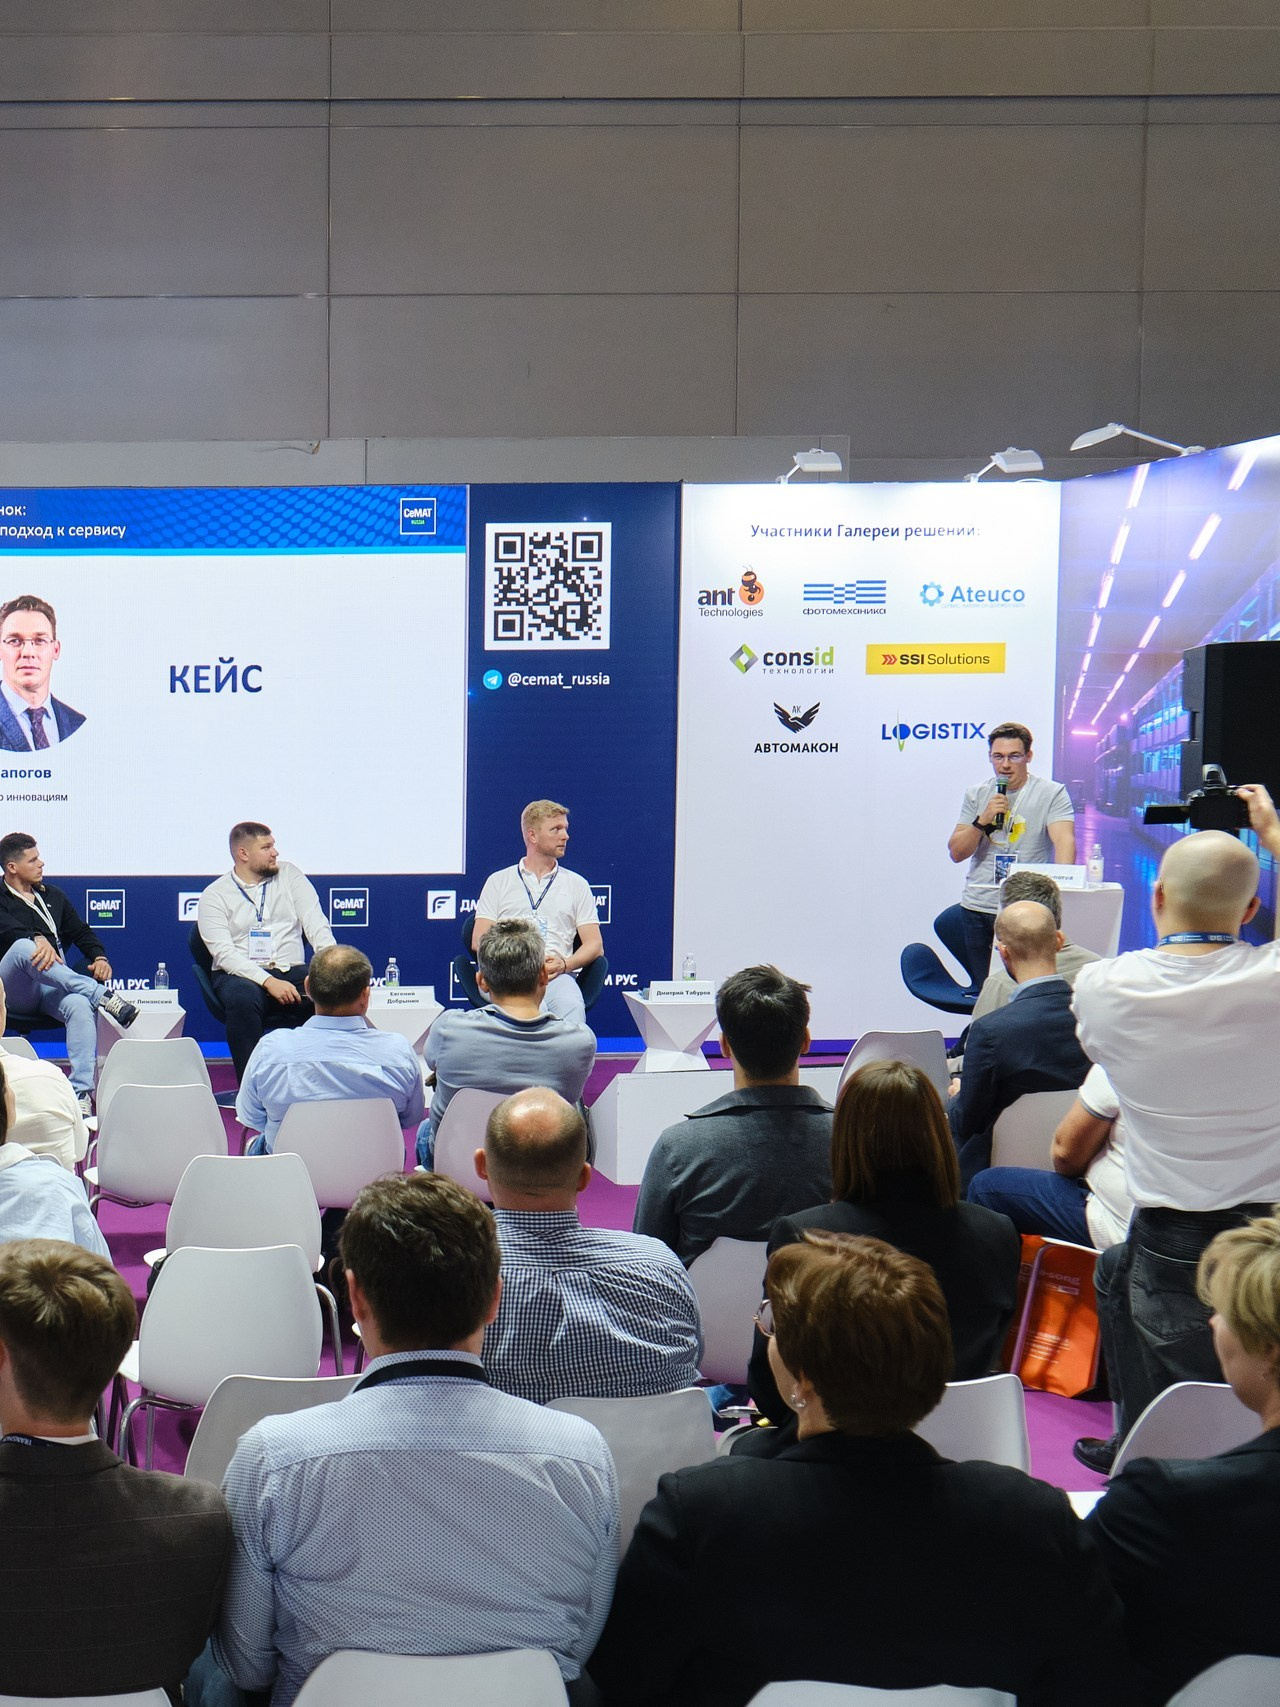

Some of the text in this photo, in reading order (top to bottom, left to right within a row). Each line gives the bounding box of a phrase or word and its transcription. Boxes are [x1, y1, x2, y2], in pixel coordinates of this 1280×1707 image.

[403, 508, 433, 518] CeMAT
[0, 525, 54, 539] подход
[57, 526, 65, 537] к
[69, 525, 127, 540] сервису
[751, 524, 981, 541] Участники Галереи решений:
[697, 586, 735, 607] ant
[950, 586, 1025, 602] Ateuco
[699, 607, 764, 619] Technologies
[802, 607, 887, 617] фотомеханика
[763, 646, 834, 666] consid
[899, 653, 990, 665] SSI Solutions
[170, 657, 262, 693] КЕЙС
[508, 672, 610, 689] @cemat_russia
[881, 722, 987, 740] LOGISTIX
[754, 742, 839, 753] АВТОМАКОН
[6, 794, 68, 803] инновациям
[90, 900, 121, 910] CeMAT
[333, 898, 365, 909] CeMAT
[127, 979, 150, 990] РУС
[615, 974, 638, 985] РУС
